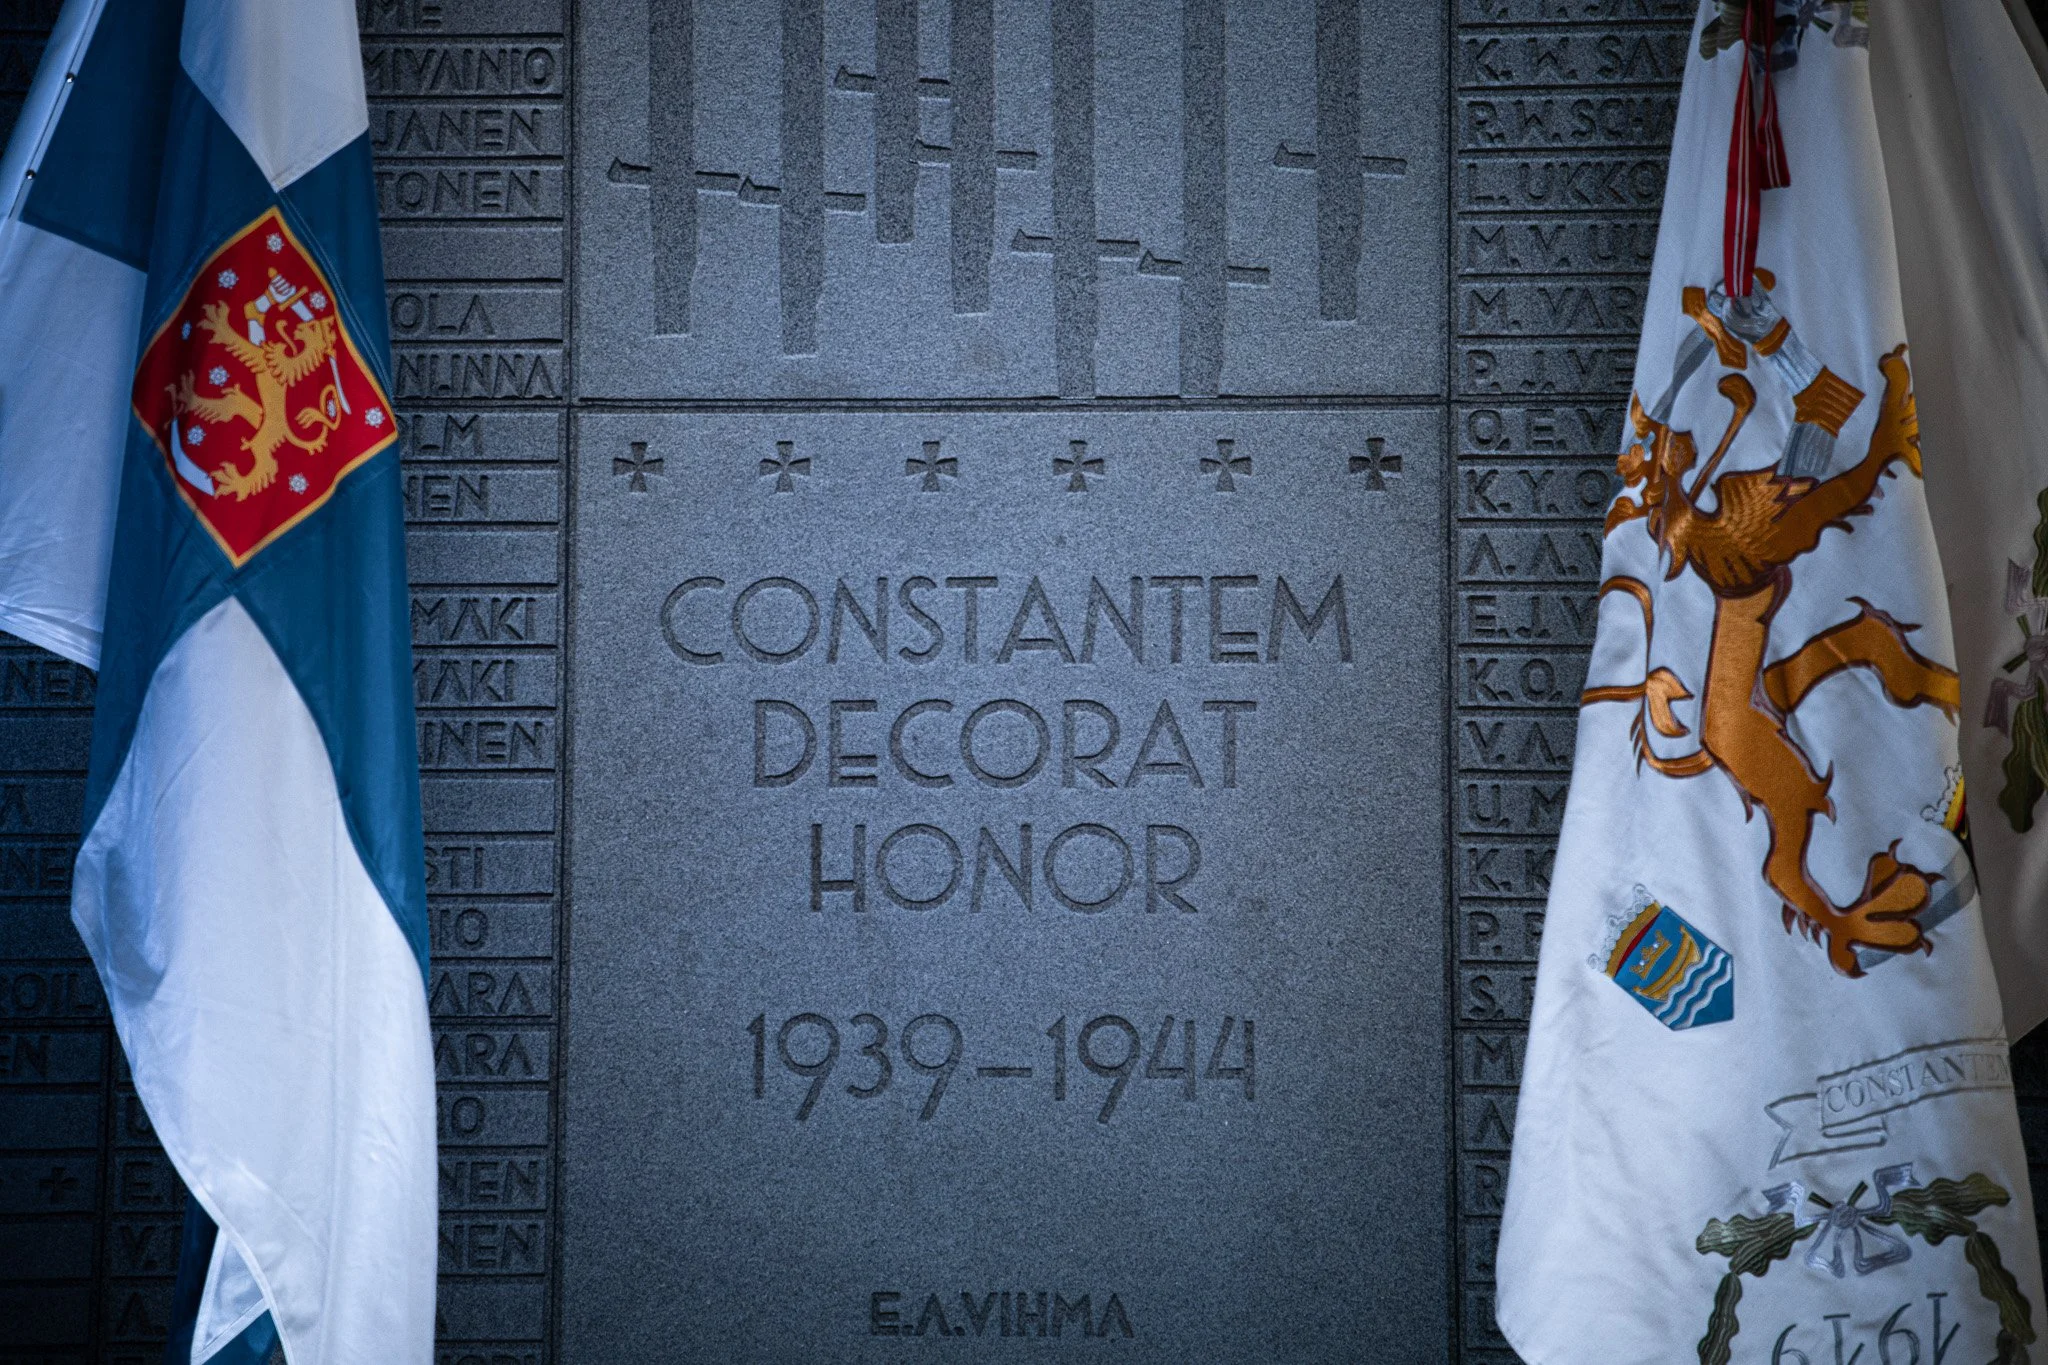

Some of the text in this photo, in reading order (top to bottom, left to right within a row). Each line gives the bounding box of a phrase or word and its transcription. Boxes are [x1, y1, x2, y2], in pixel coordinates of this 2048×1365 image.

[372, 109, 543, 151] JANEN
[376, 170, 540, 214] TONEN
[391, 293, 495, 334] OLA
[395, 353, 556, 399] NLINNA
[661, 574, 1353, 666] CONSTANTEM
[421, 719, 545, 765] INEN
[753, 699, 1257, 789] DECORAT
[808, 822, 1200, 914] HONOR
[429, 971, 537, 1014] ARA
[434, 1033, 536, 1076] ARA
[872, 1291, 1135, 1338] E.A.VIHMA
